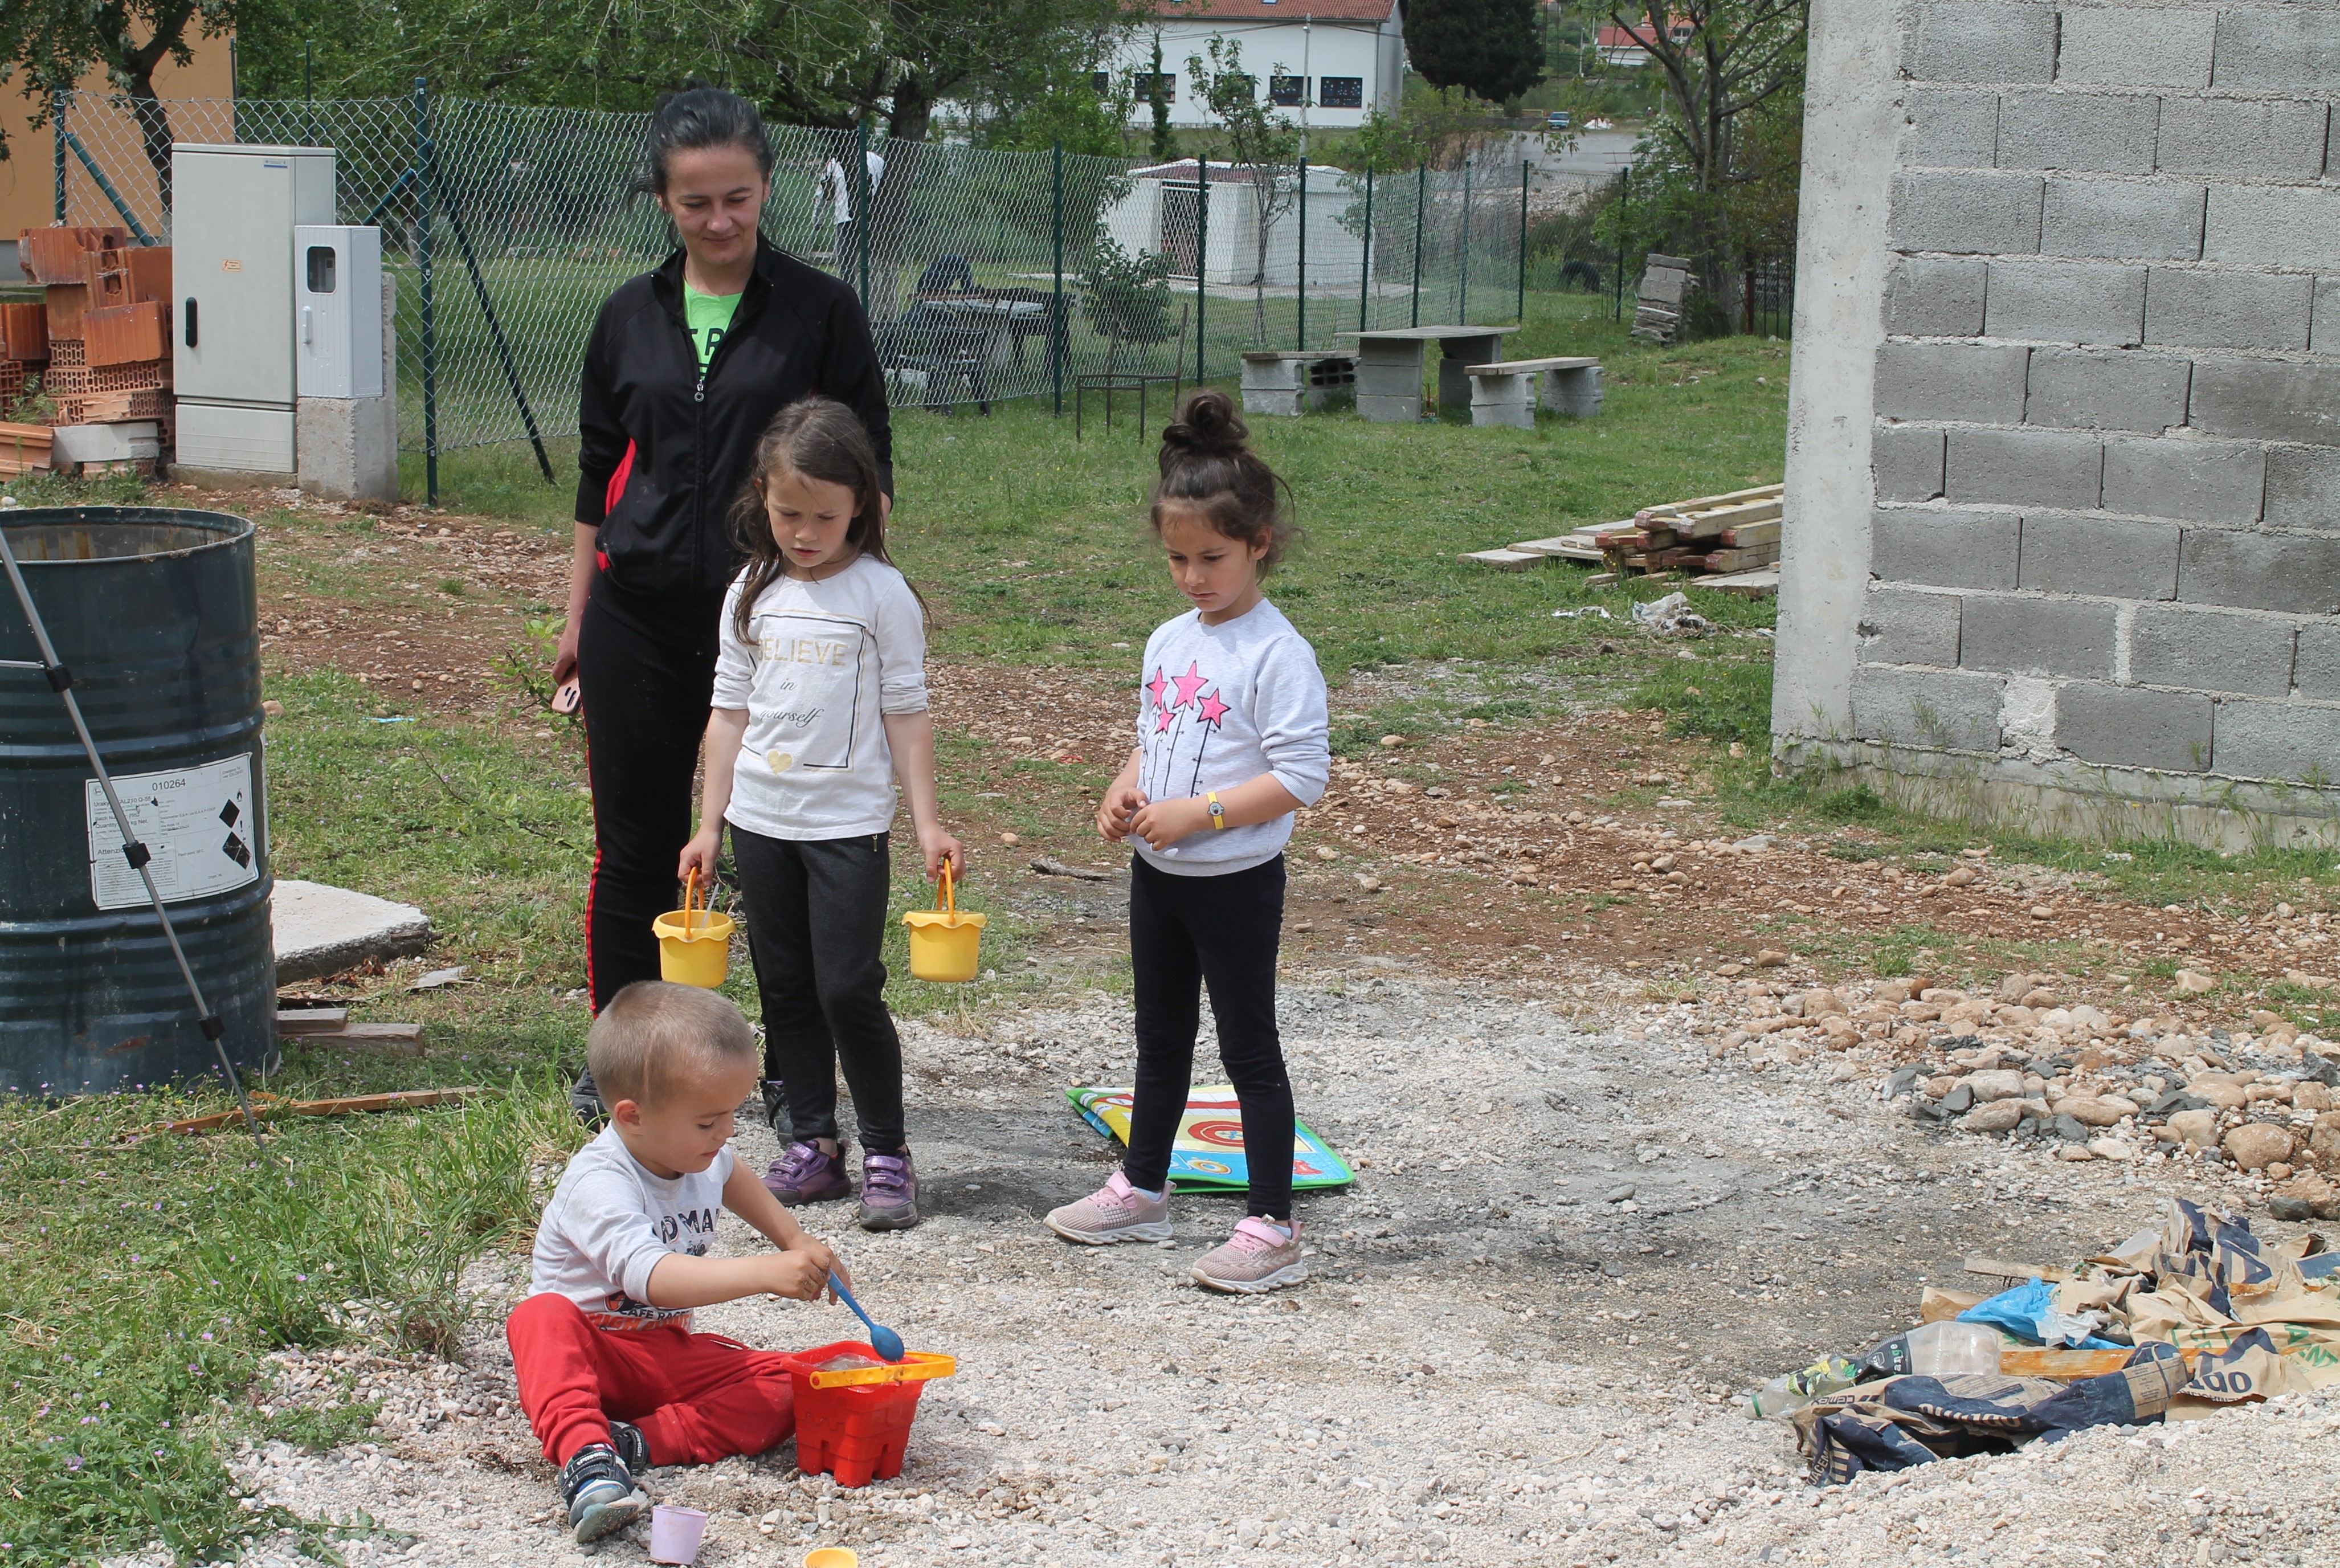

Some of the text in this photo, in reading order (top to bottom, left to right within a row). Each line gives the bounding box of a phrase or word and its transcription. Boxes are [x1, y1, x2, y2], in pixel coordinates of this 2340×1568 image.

[780, 678, 798, 691] in
[757, 708, 824, 728] yourself
[152, 778, 186, 791] 010264
[1807, 1444, 1830, 1487] JACEM
